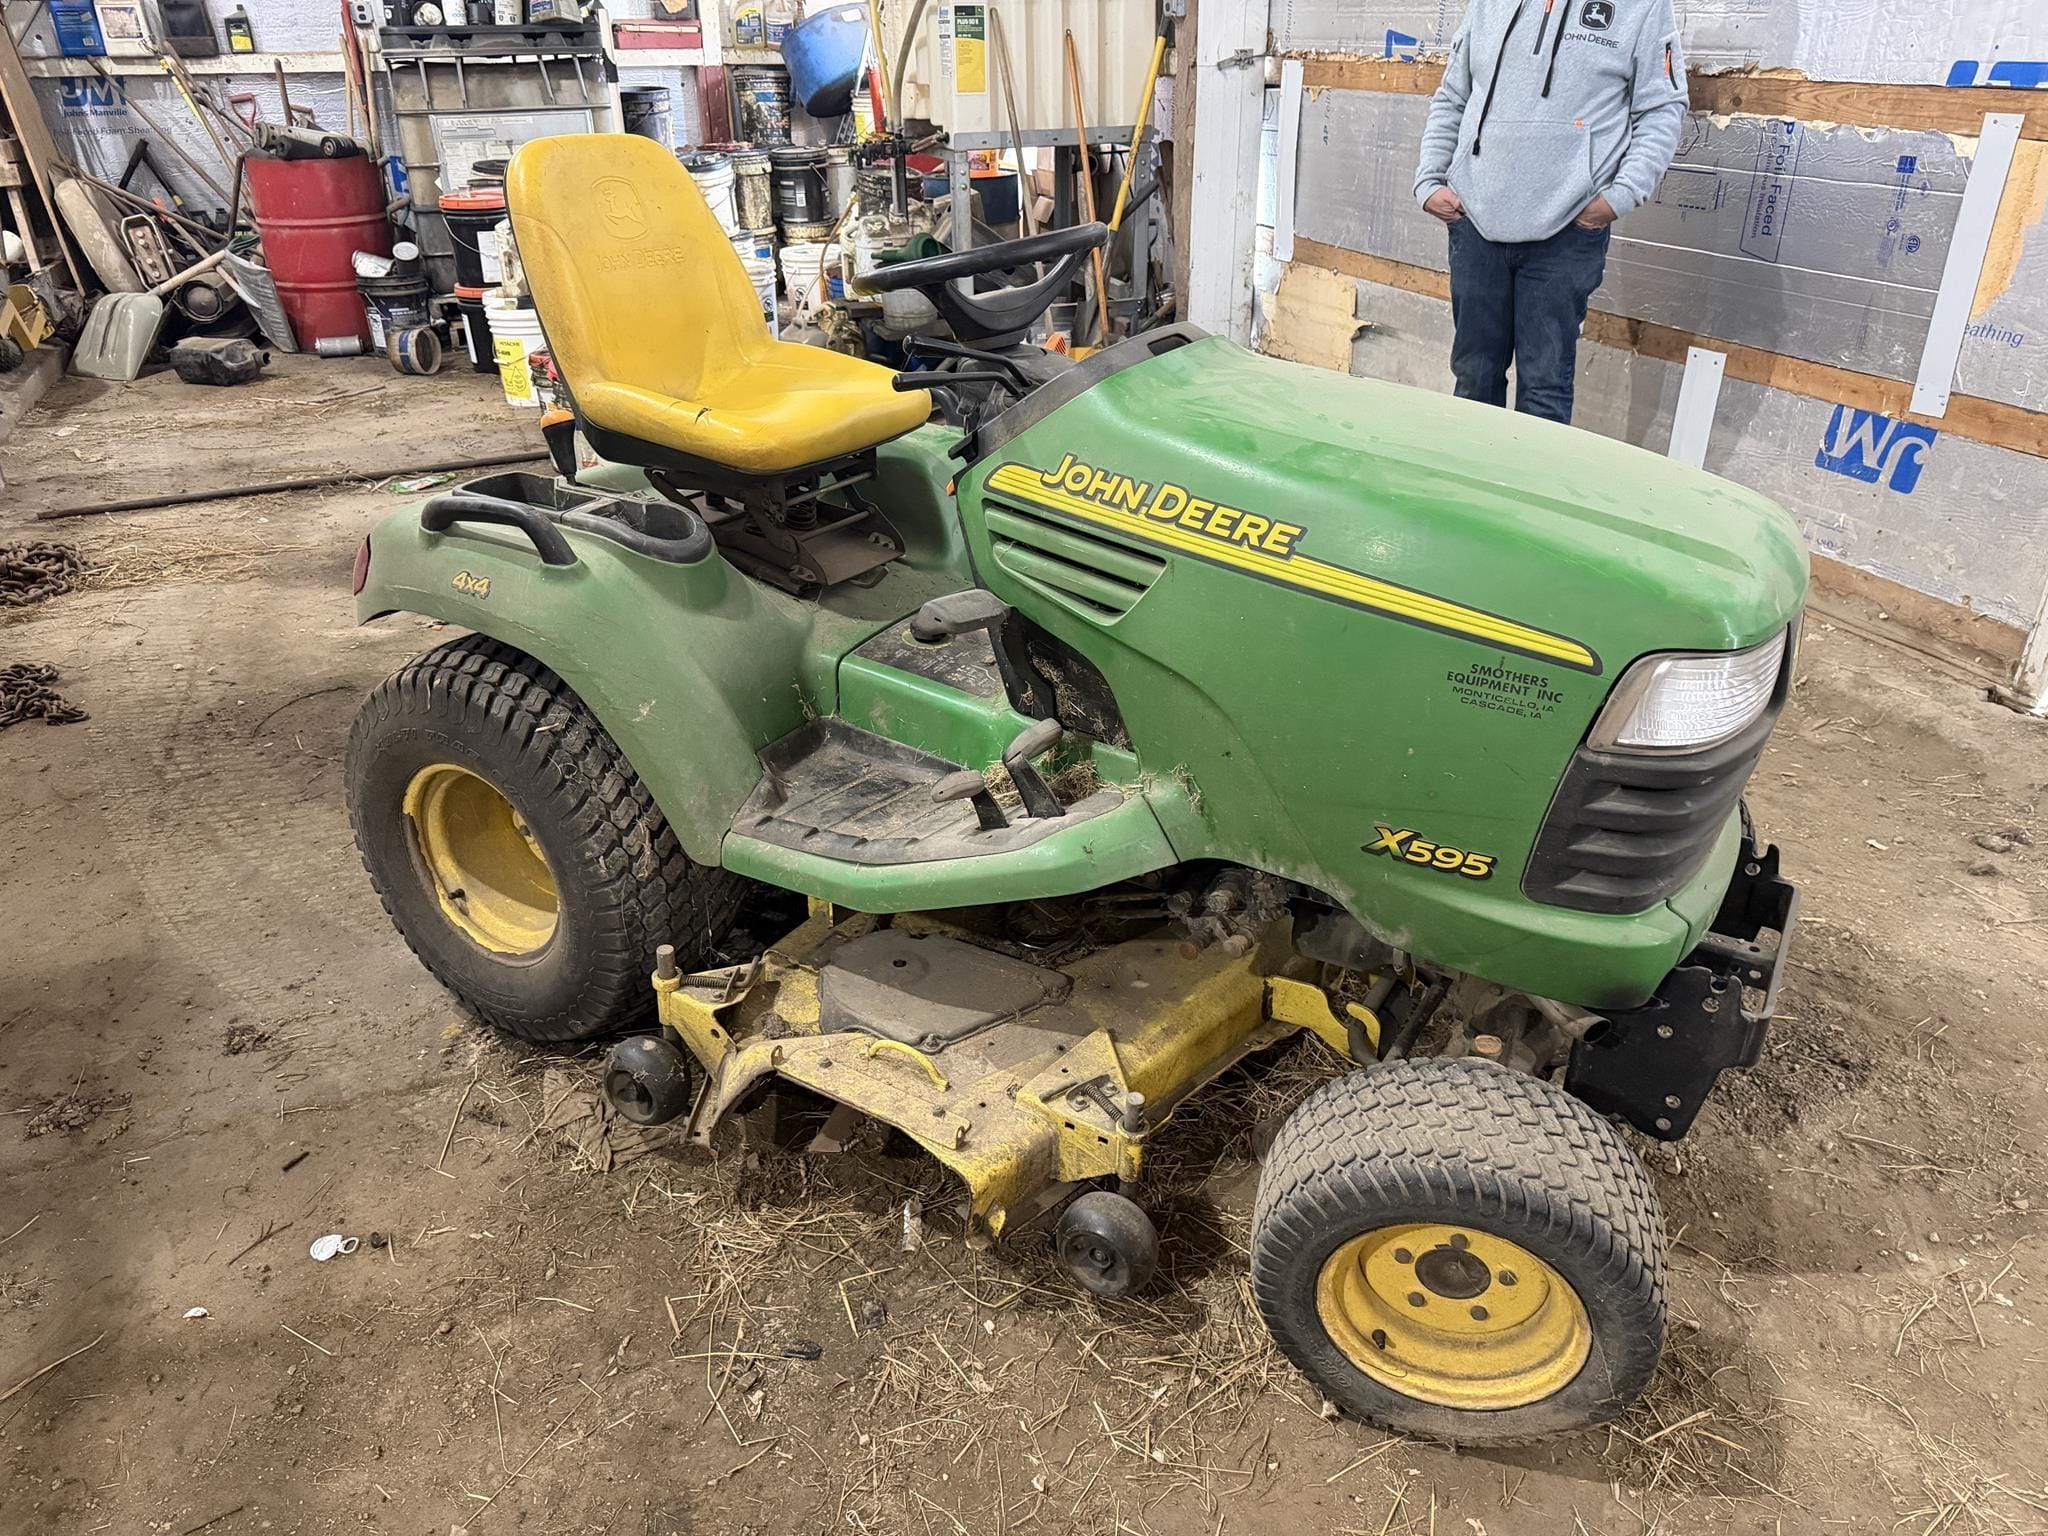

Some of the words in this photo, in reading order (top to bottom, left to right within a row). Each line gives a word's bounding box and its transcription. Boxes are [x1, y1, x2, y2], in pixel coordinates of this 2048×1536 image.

[1562, 33, 1587, 41] OHN
[1587, 34, 1620, 48] DEERE
[63, 108, 88, 117] Johns
[89, 108, 127, 117] Manville
[1761, 144, 1790, 236] Foil-Faced
[631, 247, 685, 269] DEERE
[1041, 453, 1151, 512] JOHN
[1147, 482, 1305, 558] DEERE
[451, 570, 491, 600] 4x4
[1446, 671, 1531, 697] EQUIPMENT
[1536, 689, 1563, 704] INC
[1470, 664, 1549, 688] SMOTHERS
[1452, 686, 1540, 711] MONTICELLO,
[1542, 704, 1554, 713] IA
[1460, 697, 1527, 718] CASCADE,
[1530, 711, 1542, 719] IA
[1360, 826, 1498, 881] X595
